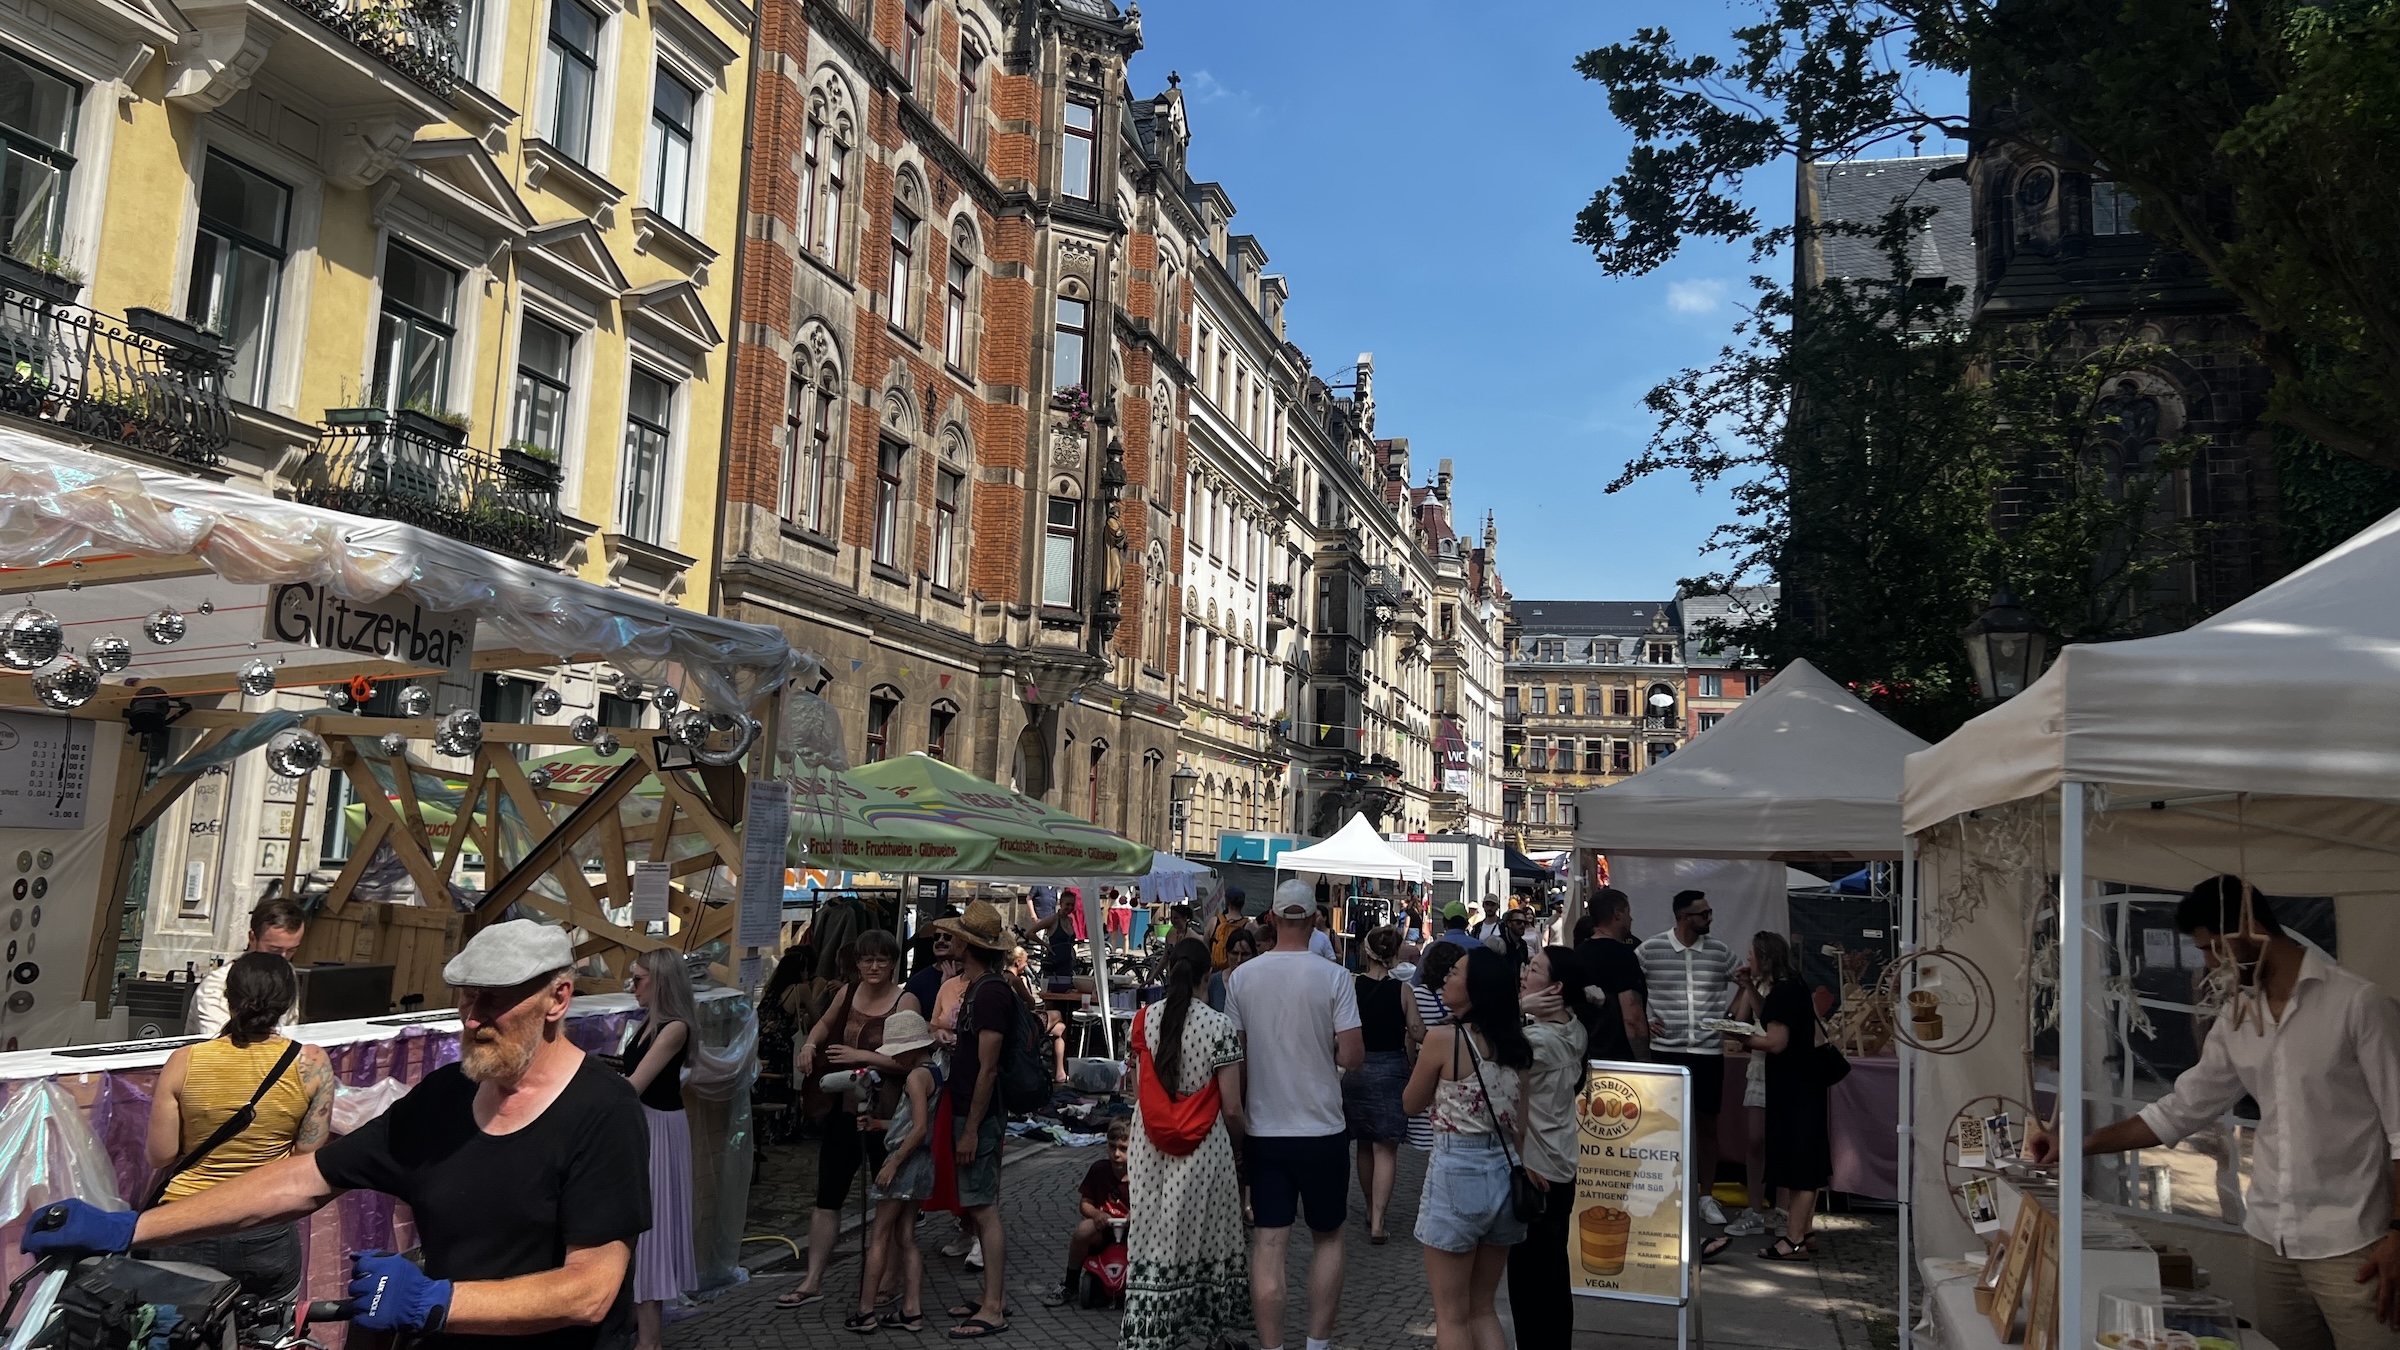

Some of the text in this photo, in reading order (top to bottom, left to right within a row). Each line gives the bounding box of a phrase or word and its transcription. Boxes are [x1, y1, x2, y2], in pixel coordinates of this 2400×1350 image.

[274, 581, 463, 667] Glitzerbar
[1447, 750, 1465, 762] WC
[809, 837, 859, 856] Frucäfte
[866, 840, 913, 857] Fruchtweine
[1000, 837, 1040, 853] Fruchtsäfte
[1044, 843, 1084, 858] Fruchtweine
[941, 882, 946, 895] P
[1584, 1119, 1630, 1136] KARAWE
[1580, 1144, 1680, 1161] ND & LECKER
[1577, 1166, 1663, 1180] TOFFREICHE NÜSSE
[1595, 1180, 1645, 1190] ANGENEHM
[1580, 1190, 1629, 1201] SÄTTIGEND
[1585, 1278, 1620, 1289] VEGAN
